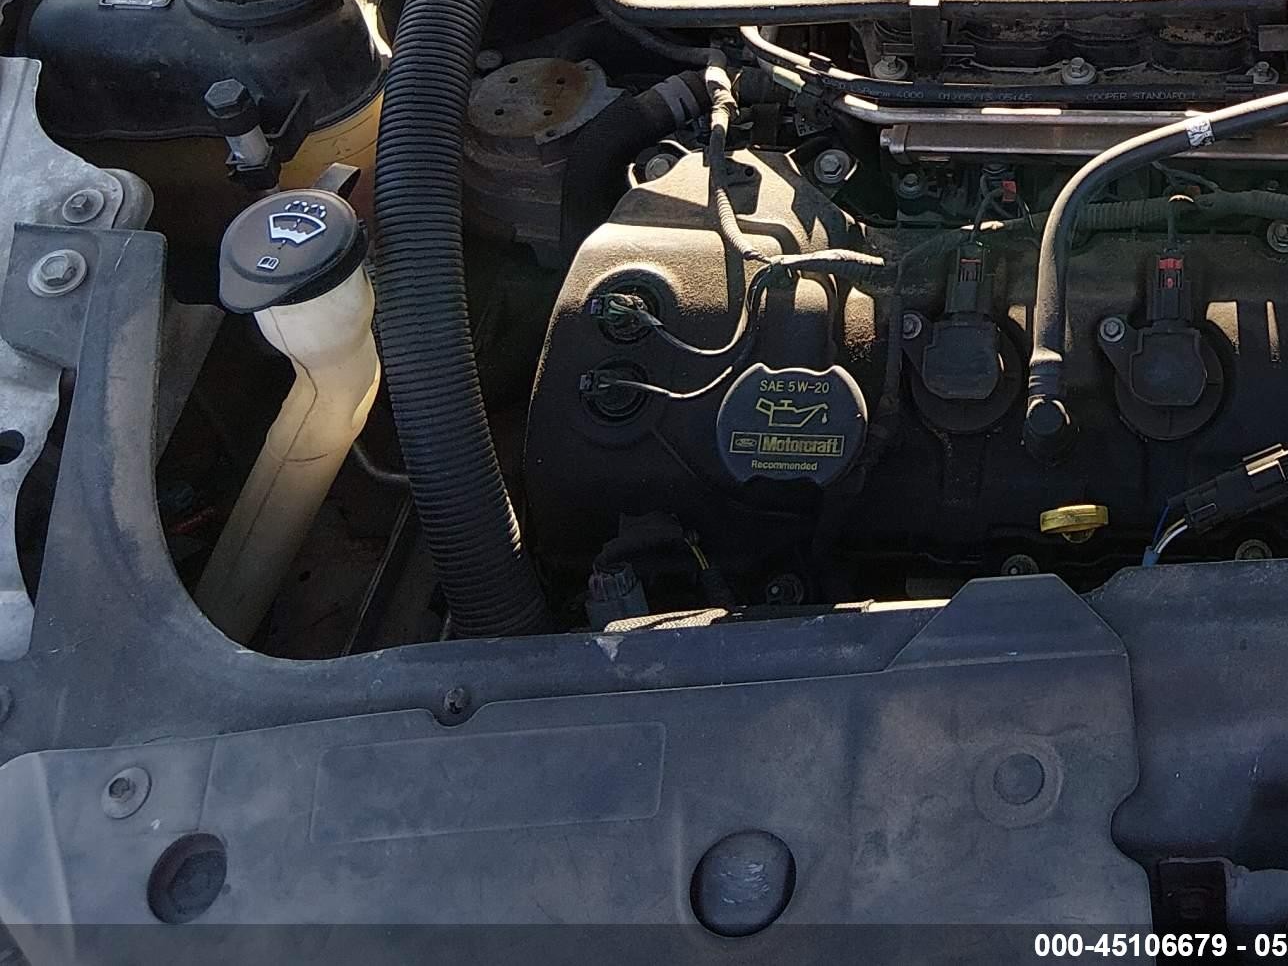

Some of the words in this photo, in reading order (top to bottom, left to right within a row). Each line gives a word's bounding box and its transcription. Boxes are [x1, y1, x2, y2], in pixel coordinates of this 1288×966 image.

[1086, 91, 1128, 101] COOPER
[1131, 90, 1187, 100] STANDARD
[760, 380, 785, 393] SAE
[788, 381, 830, 394] 5W-20
[762, 436, 838, 454] Motorcraft
[751, 459, 818, 471] Recommended
